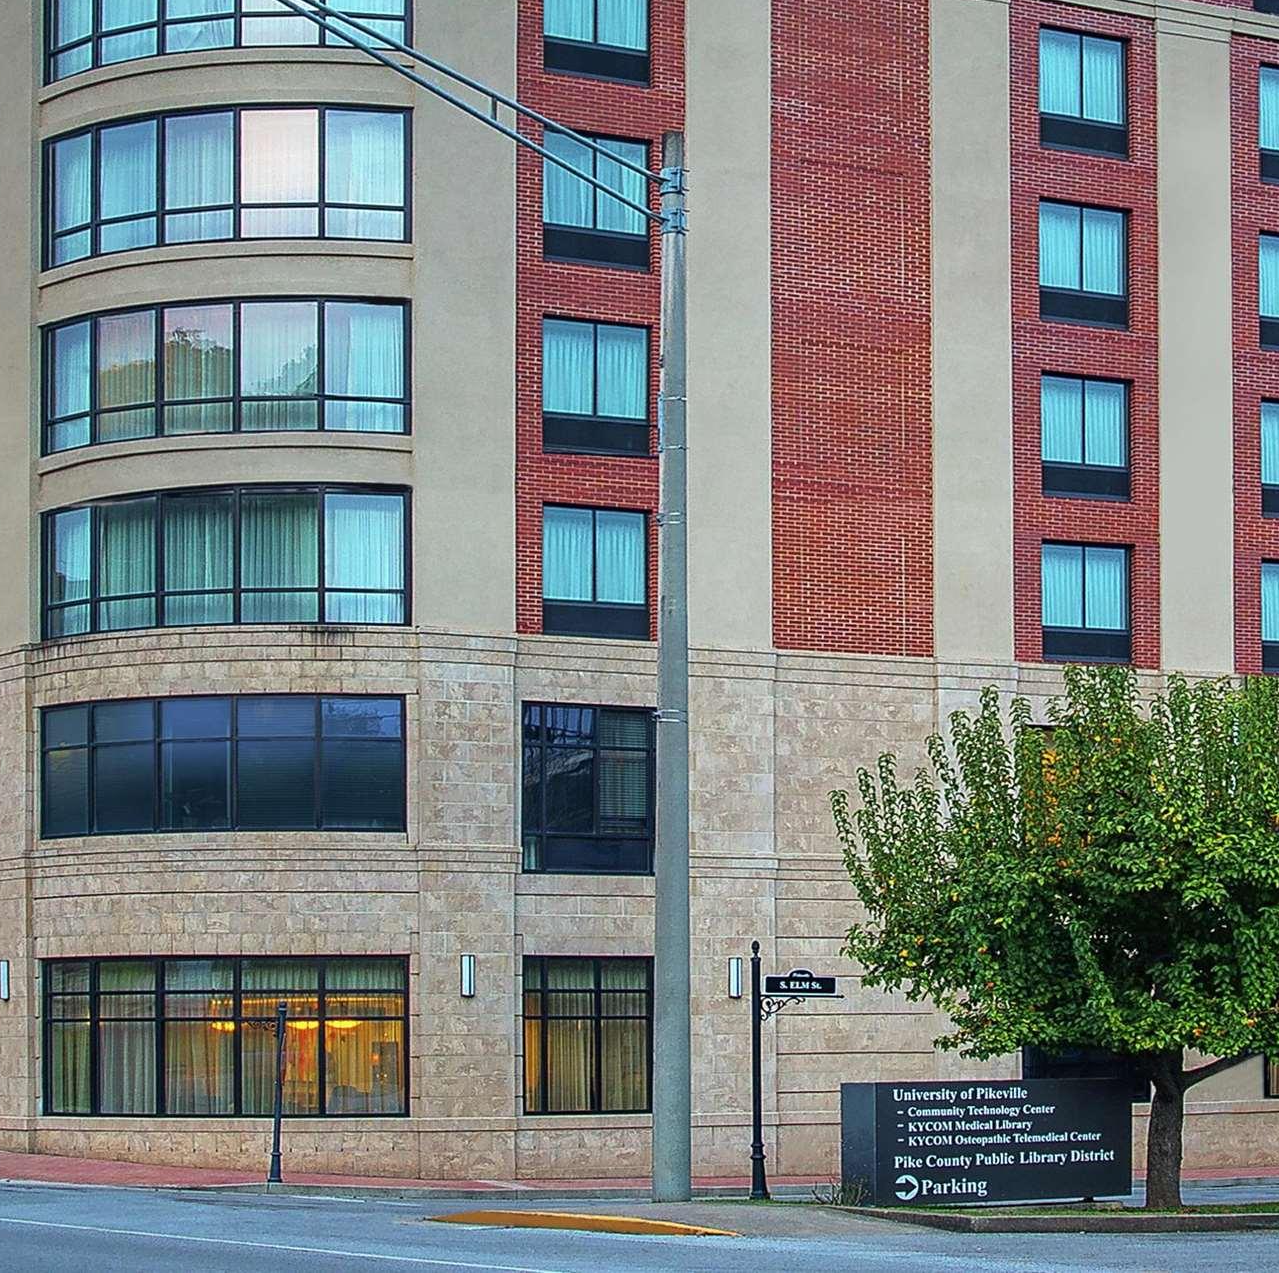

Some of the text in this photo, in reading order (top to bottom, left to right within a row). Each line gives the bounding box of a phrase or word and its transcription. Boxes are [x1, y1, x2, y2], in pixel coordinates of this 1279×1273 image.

[789, 981, 810, 990] ELM
[893, 1087, 1028, 1103] University of Pikeville
[907, 1104, 1056, 1118] Community Technology Center
[908, 1120, 1033, 1132] KYCOM Medical Library
[908, 1131, 1101, 1147] KYCOM Osteopathic Telemedical Center
[894, 1148, 1115, 1169] Pike County Public Library District
[921, 1177, 988, 1197] Parking
